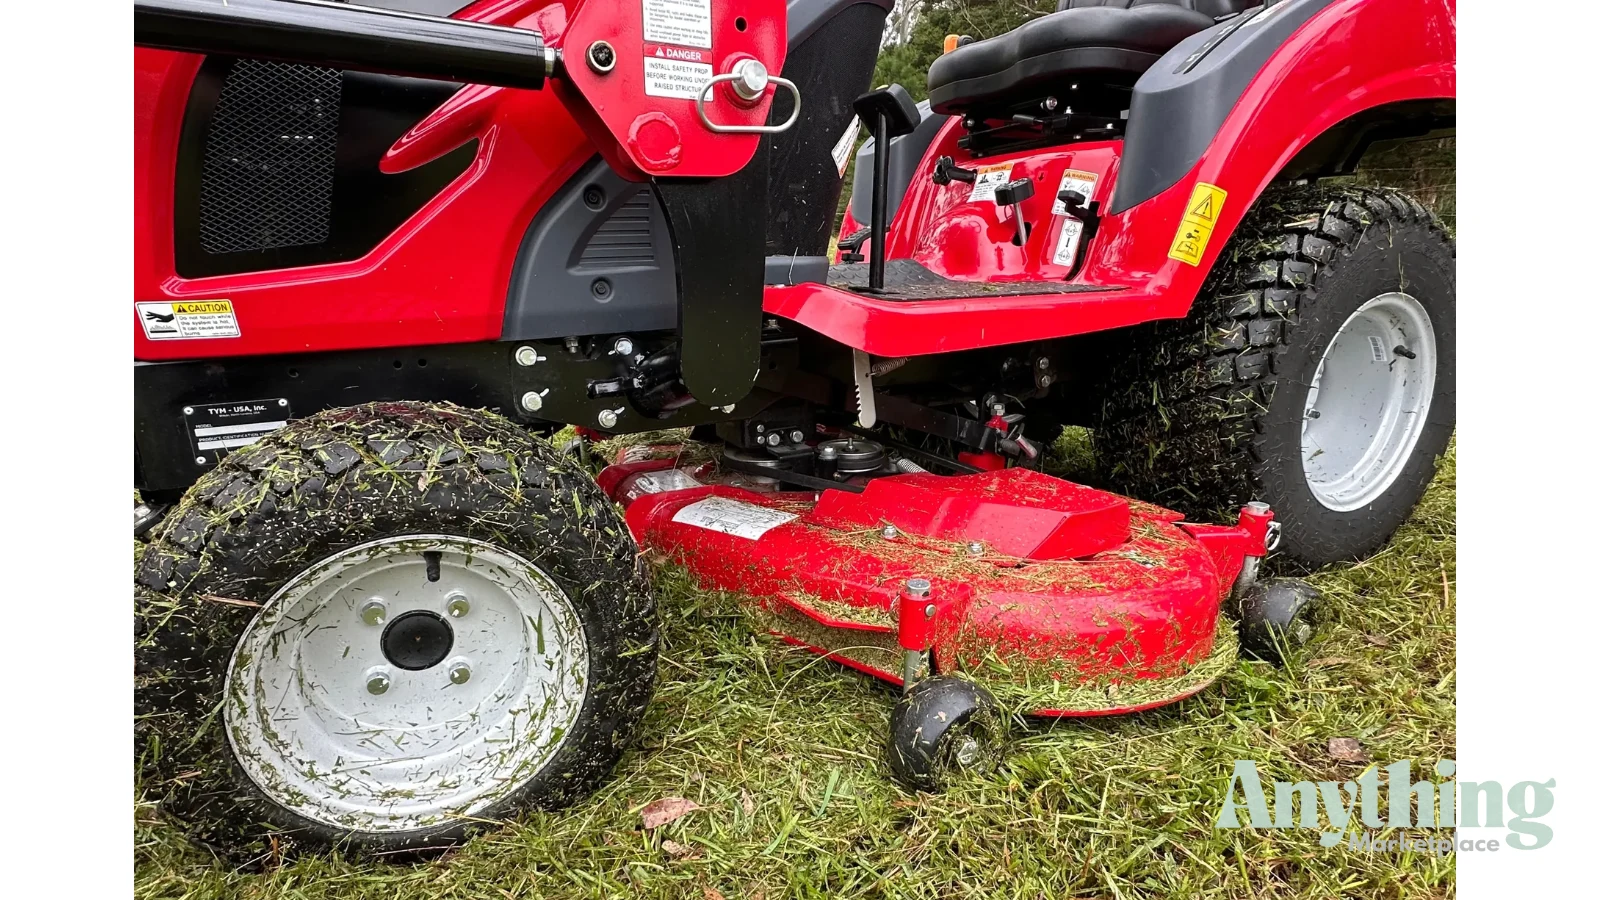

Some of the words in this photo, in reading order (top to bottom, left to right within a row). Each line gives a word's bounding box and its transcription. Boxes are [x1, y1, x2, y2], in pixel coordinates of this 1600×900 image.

[666, 48, 702, 61] DANGER
[649, 63, 671, 71] INSTALL
[672, 65, 693, 73] SAFETY
[694, 67, 708, 75] PROP
[646, 71, 667, 80] BEFORE
[669, 75, 693, 83] WORKING
[654, 82, 674, 91] RAISED
[675, 84, 702, 93] STRUCTUR
[187, 303, 228, 313] CAUTION
[199, 312, 216, 320] touch
[207, 407, 227, 415] TYM
[233, 405, 252, 413] USA,
